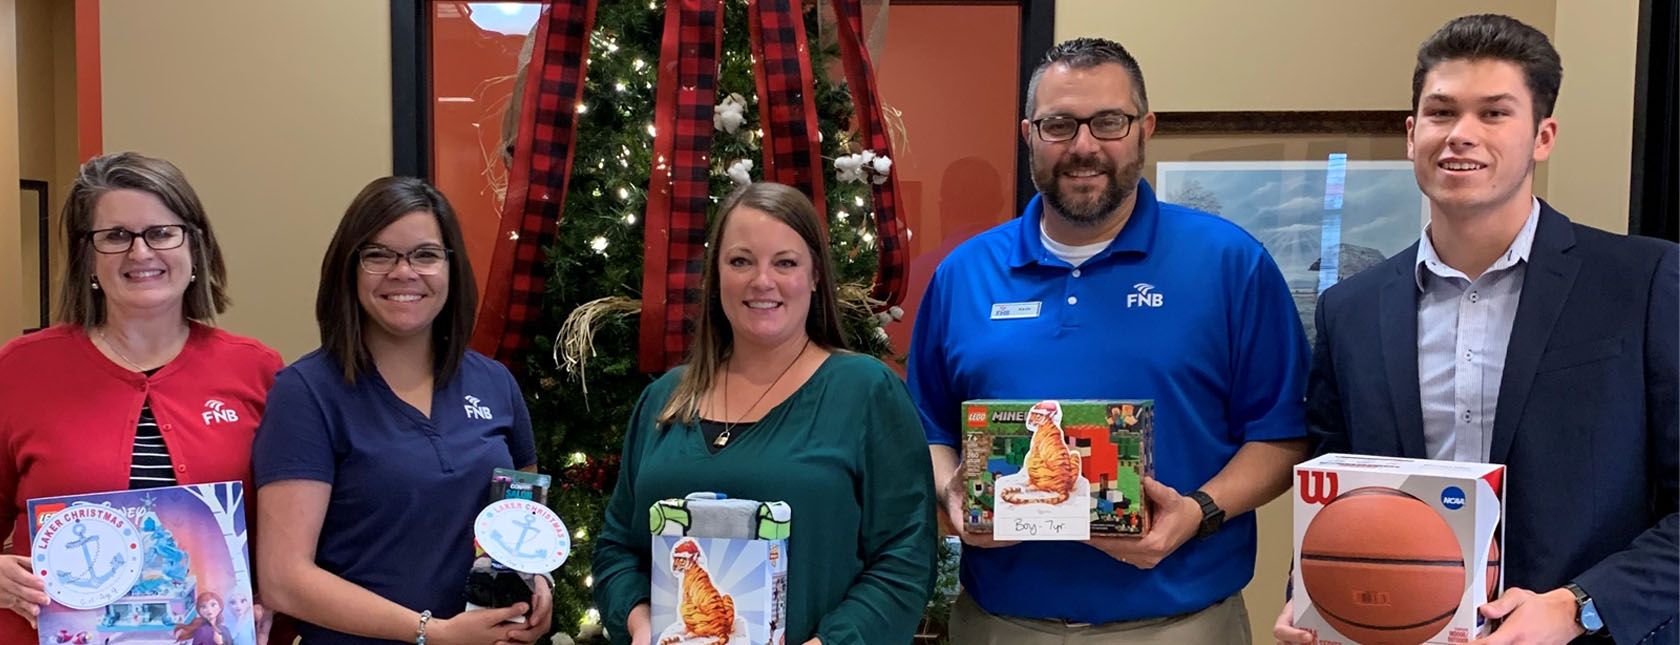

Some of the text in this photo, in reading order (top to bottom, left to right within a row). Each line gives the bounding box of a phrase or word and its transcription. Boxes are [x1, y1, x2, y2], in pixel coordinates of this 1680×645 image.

[1127, 293, 1163, 308] FNB
[202, 408, 238, 425] FNB
[465, 405, 493, 420] FNB
[968, 413, 986, 421] LEGO
[39, 508, 124, 549] LAKER CHRISTMAS
[495, 502, 564, 538] LAKER CHRISTMAS
[1014, 518, 1037, 536] Boy
